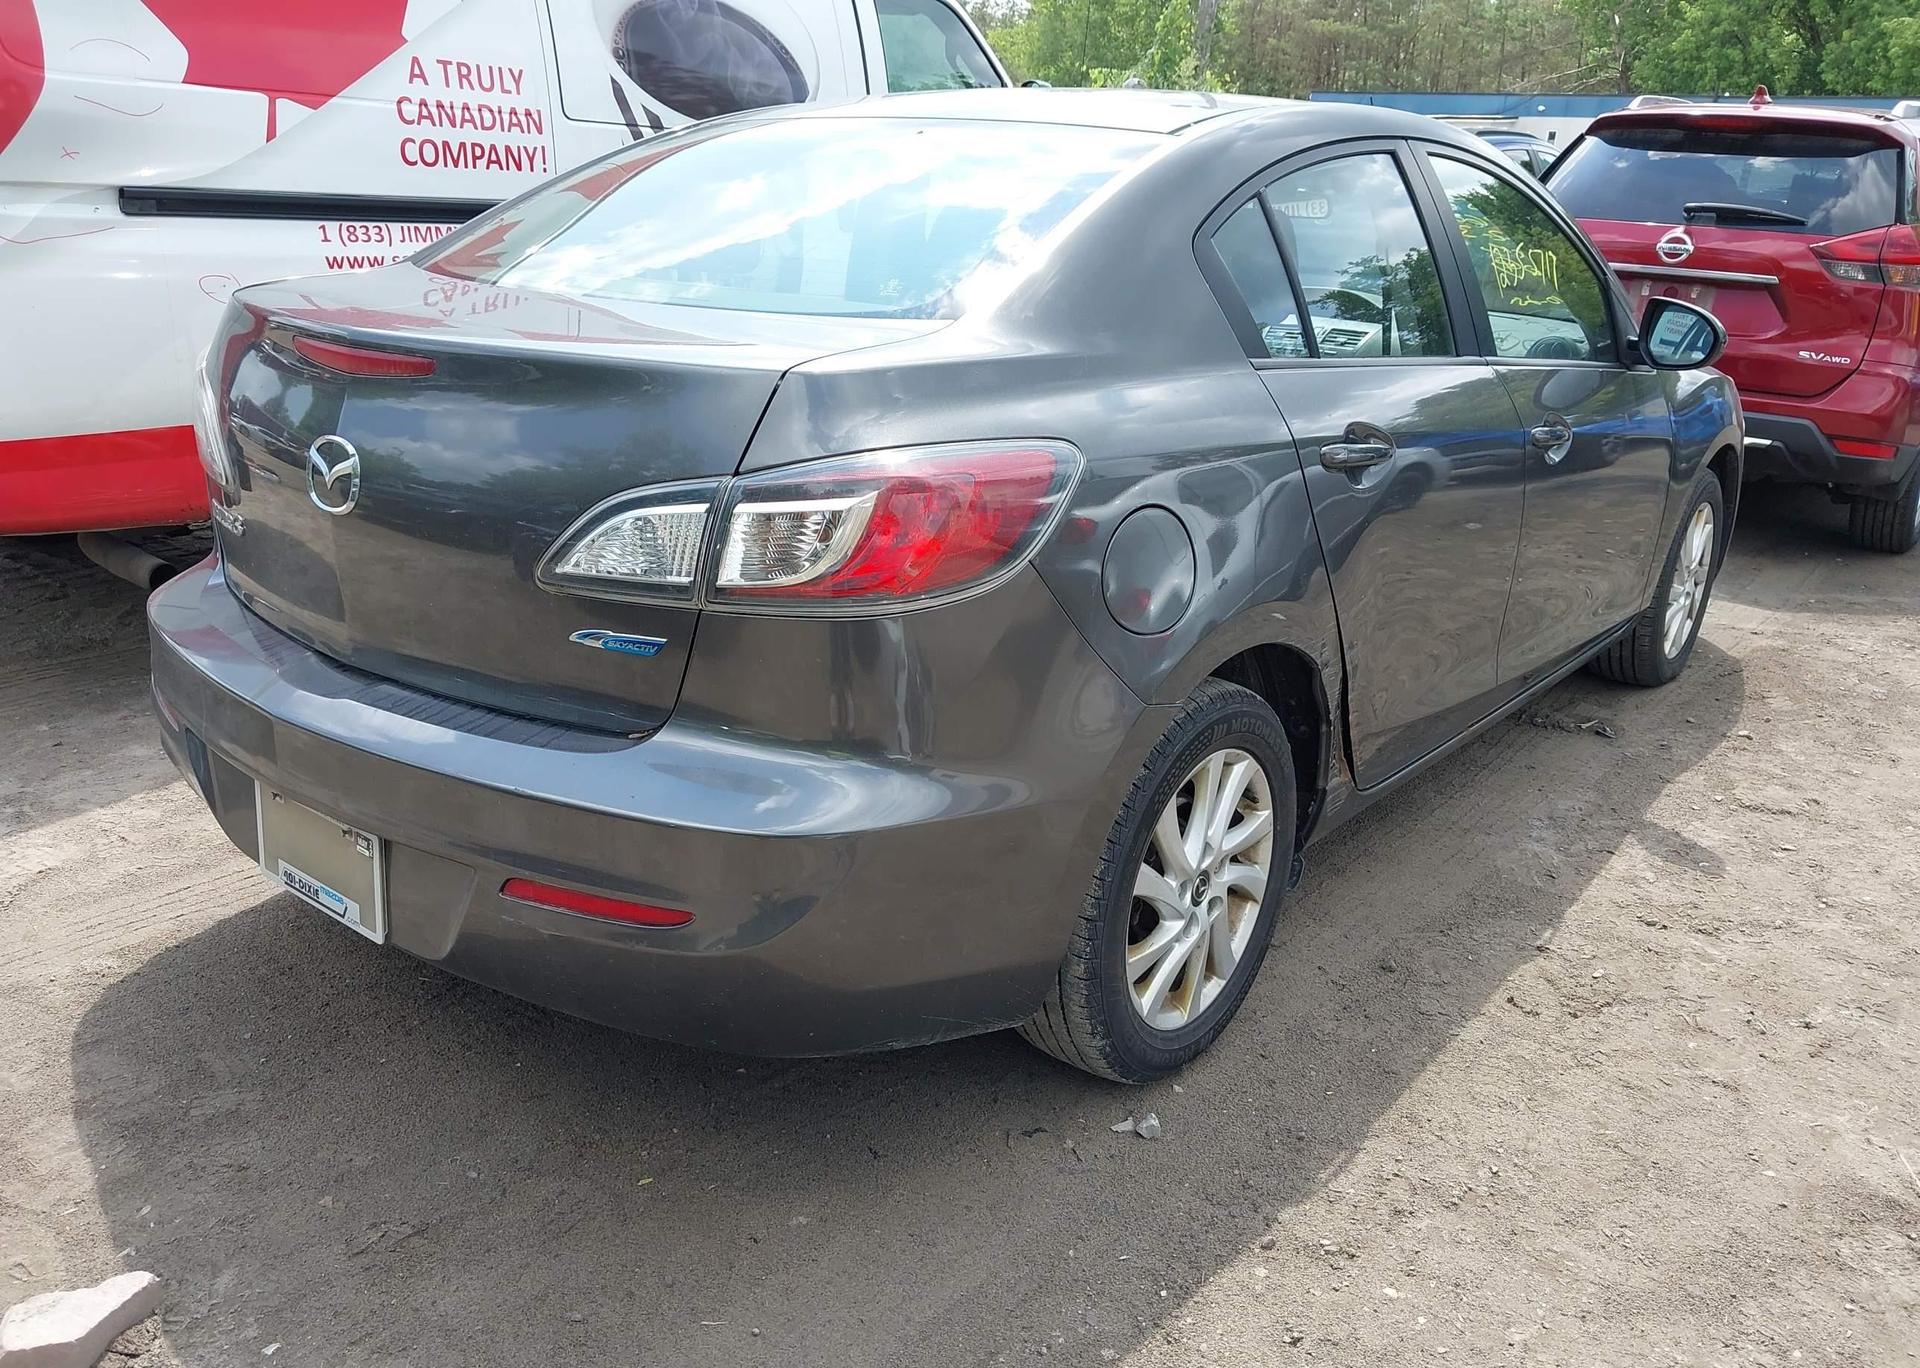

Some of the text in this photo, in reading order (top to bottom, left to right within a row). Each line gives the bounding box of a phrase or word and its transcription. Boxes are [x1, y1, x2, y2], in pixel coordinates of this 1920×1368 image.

[408, 56, 523, 95] A TRULY
[396, 96, 544, 135] CANADIAN
[400, 137, 547, 173] COMPANY!
[318, 224, 332, 243] 1
[338, 223, 393, 247] (833)
[1798, 350, 1851, 364] SV AWD
[607, 640, 658, 652] SKYACTIV
